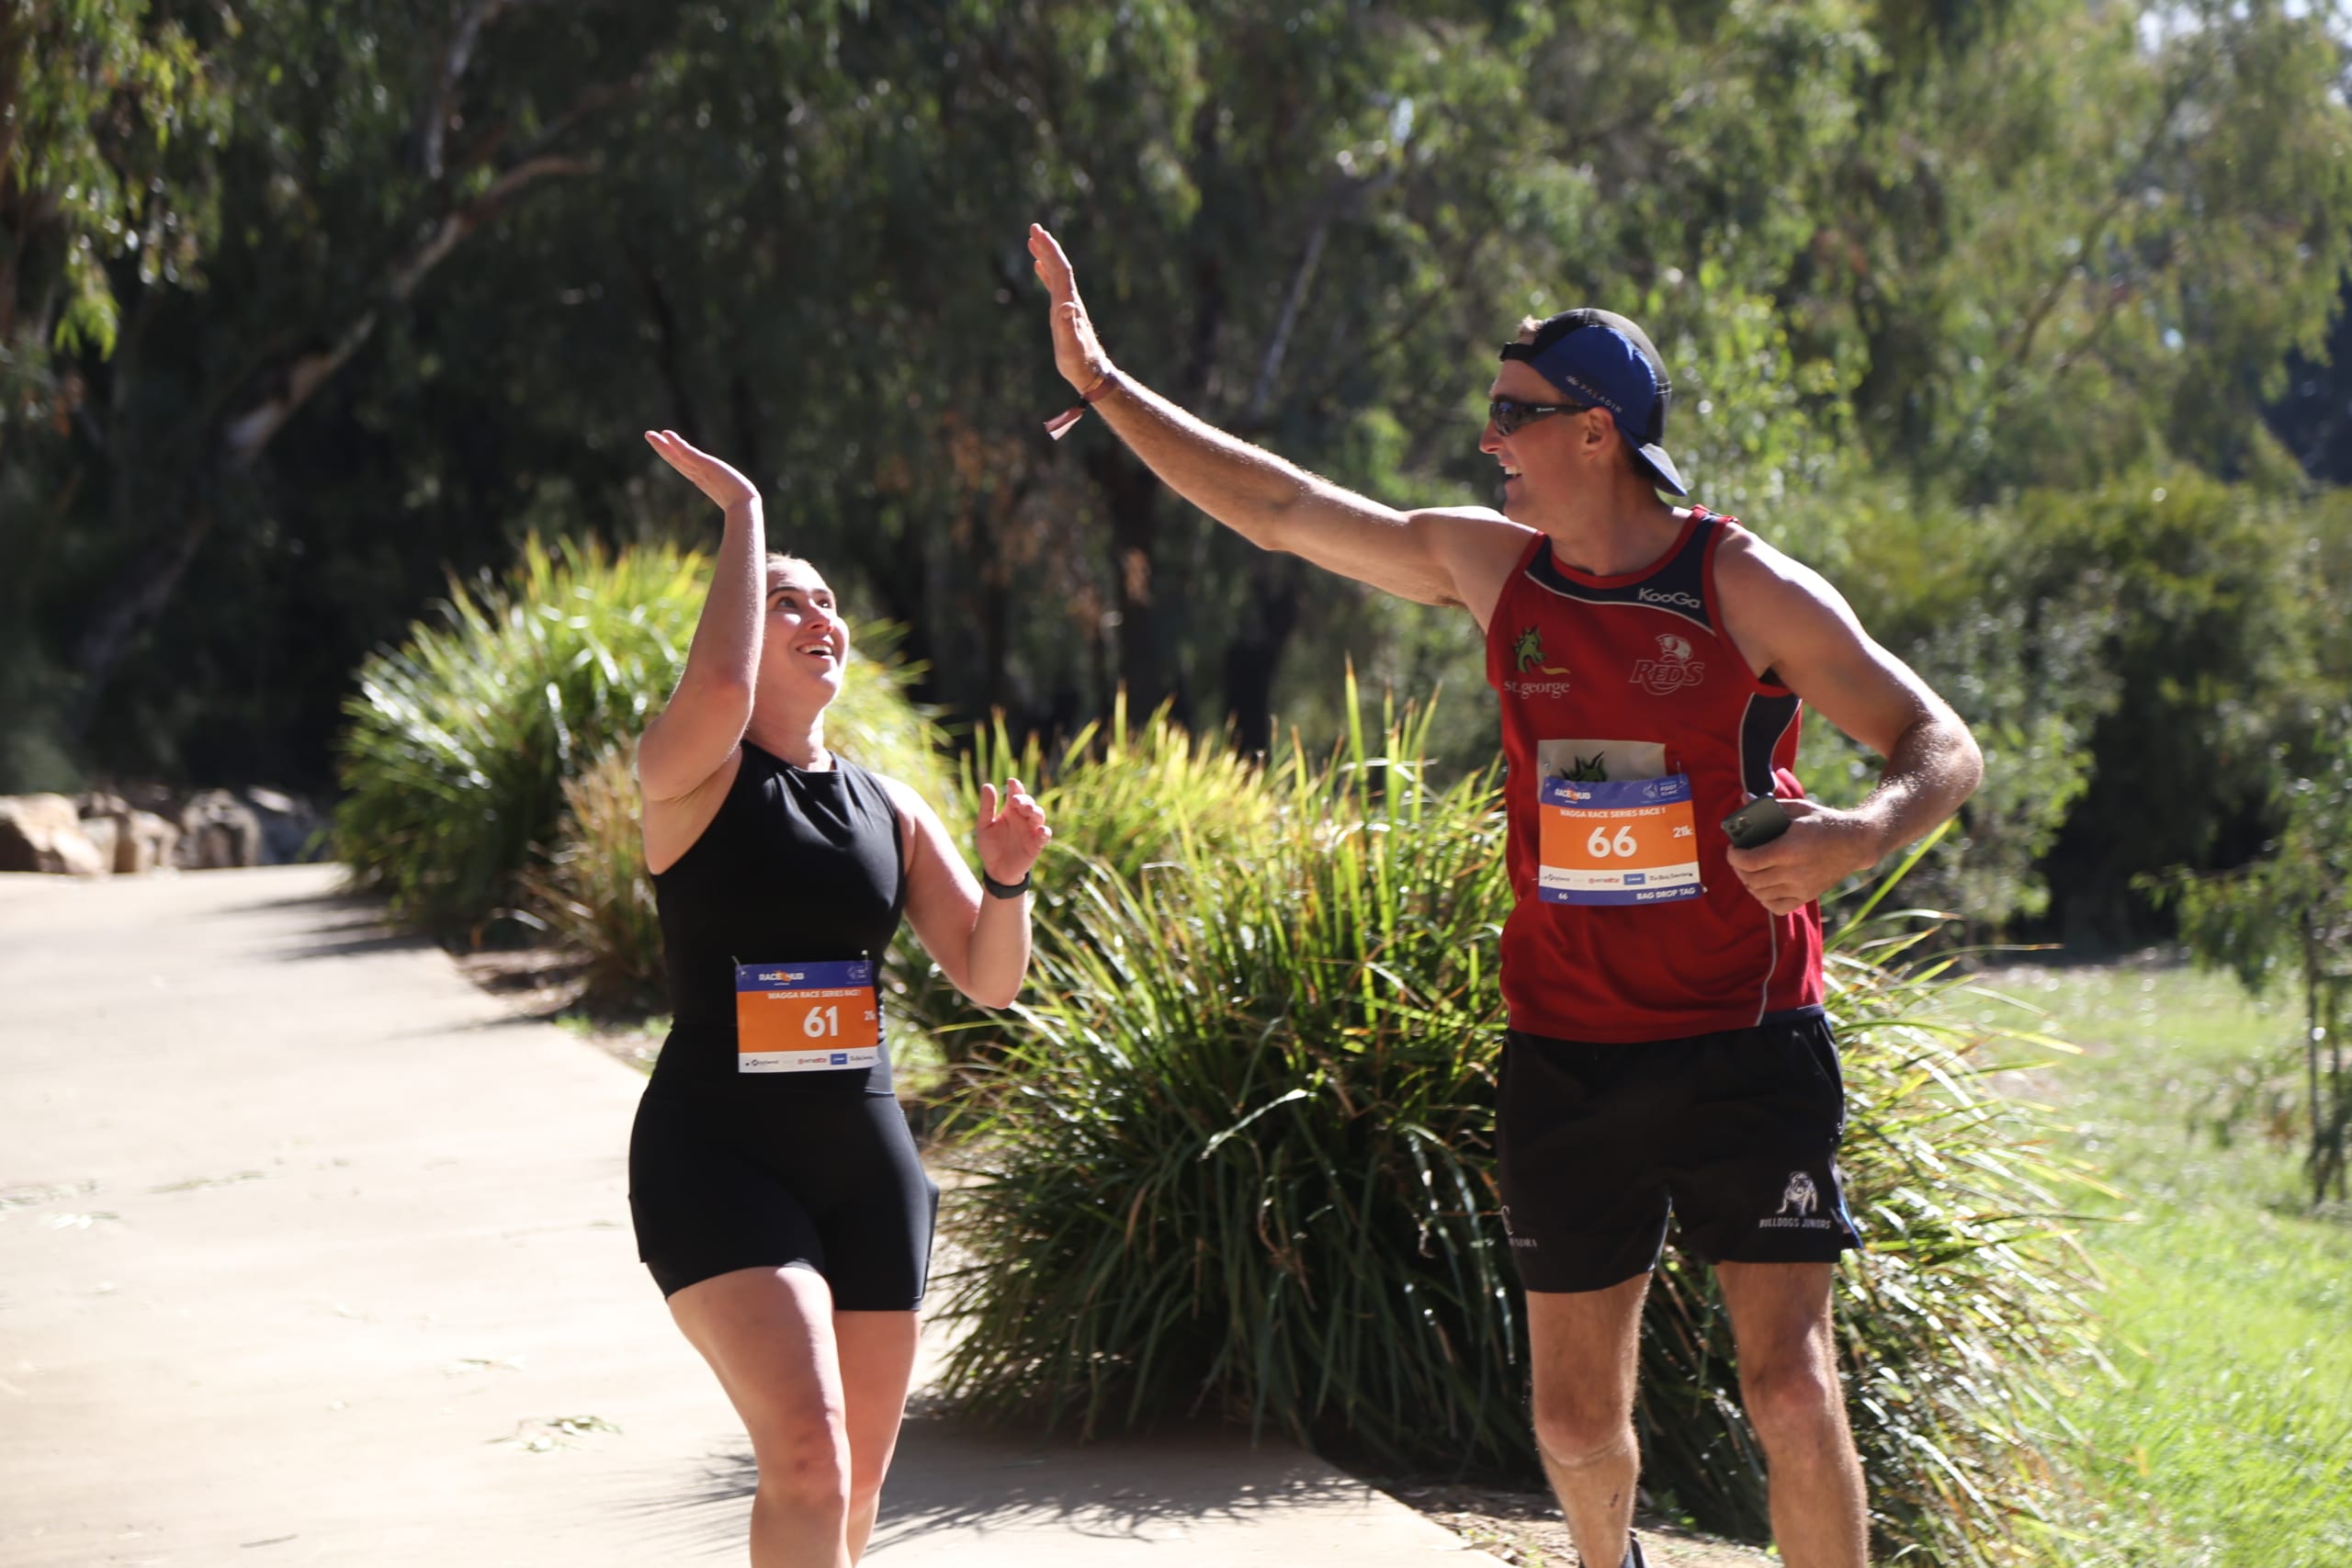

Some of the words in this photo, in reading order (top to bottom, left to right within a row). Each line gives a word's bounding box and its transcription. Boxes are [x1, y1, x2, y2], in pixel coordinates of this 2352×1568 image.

[1638, 588, 1701, 608] KooGa
[1628, 660, 1704, 687] REDS
[1560, 809, 1587, 818] WAGGA
[1610, 809, 1637, 818] SERIES
[1639, 807, 1660, 816] RACE
[1588, 825, 1637, 858] 66
[1557, 892, 1568, 900] 66
[1636, 891, 1655, 900] BAG
[1656, 889, 1678, 898] DROP
[1679, 887, 1696, 896] TAG
[800, 990, 820, 998] RACE
[803, 1006, 838, 1038] 61
[1759, 1217, 1800, 1228] BULLDOGS
